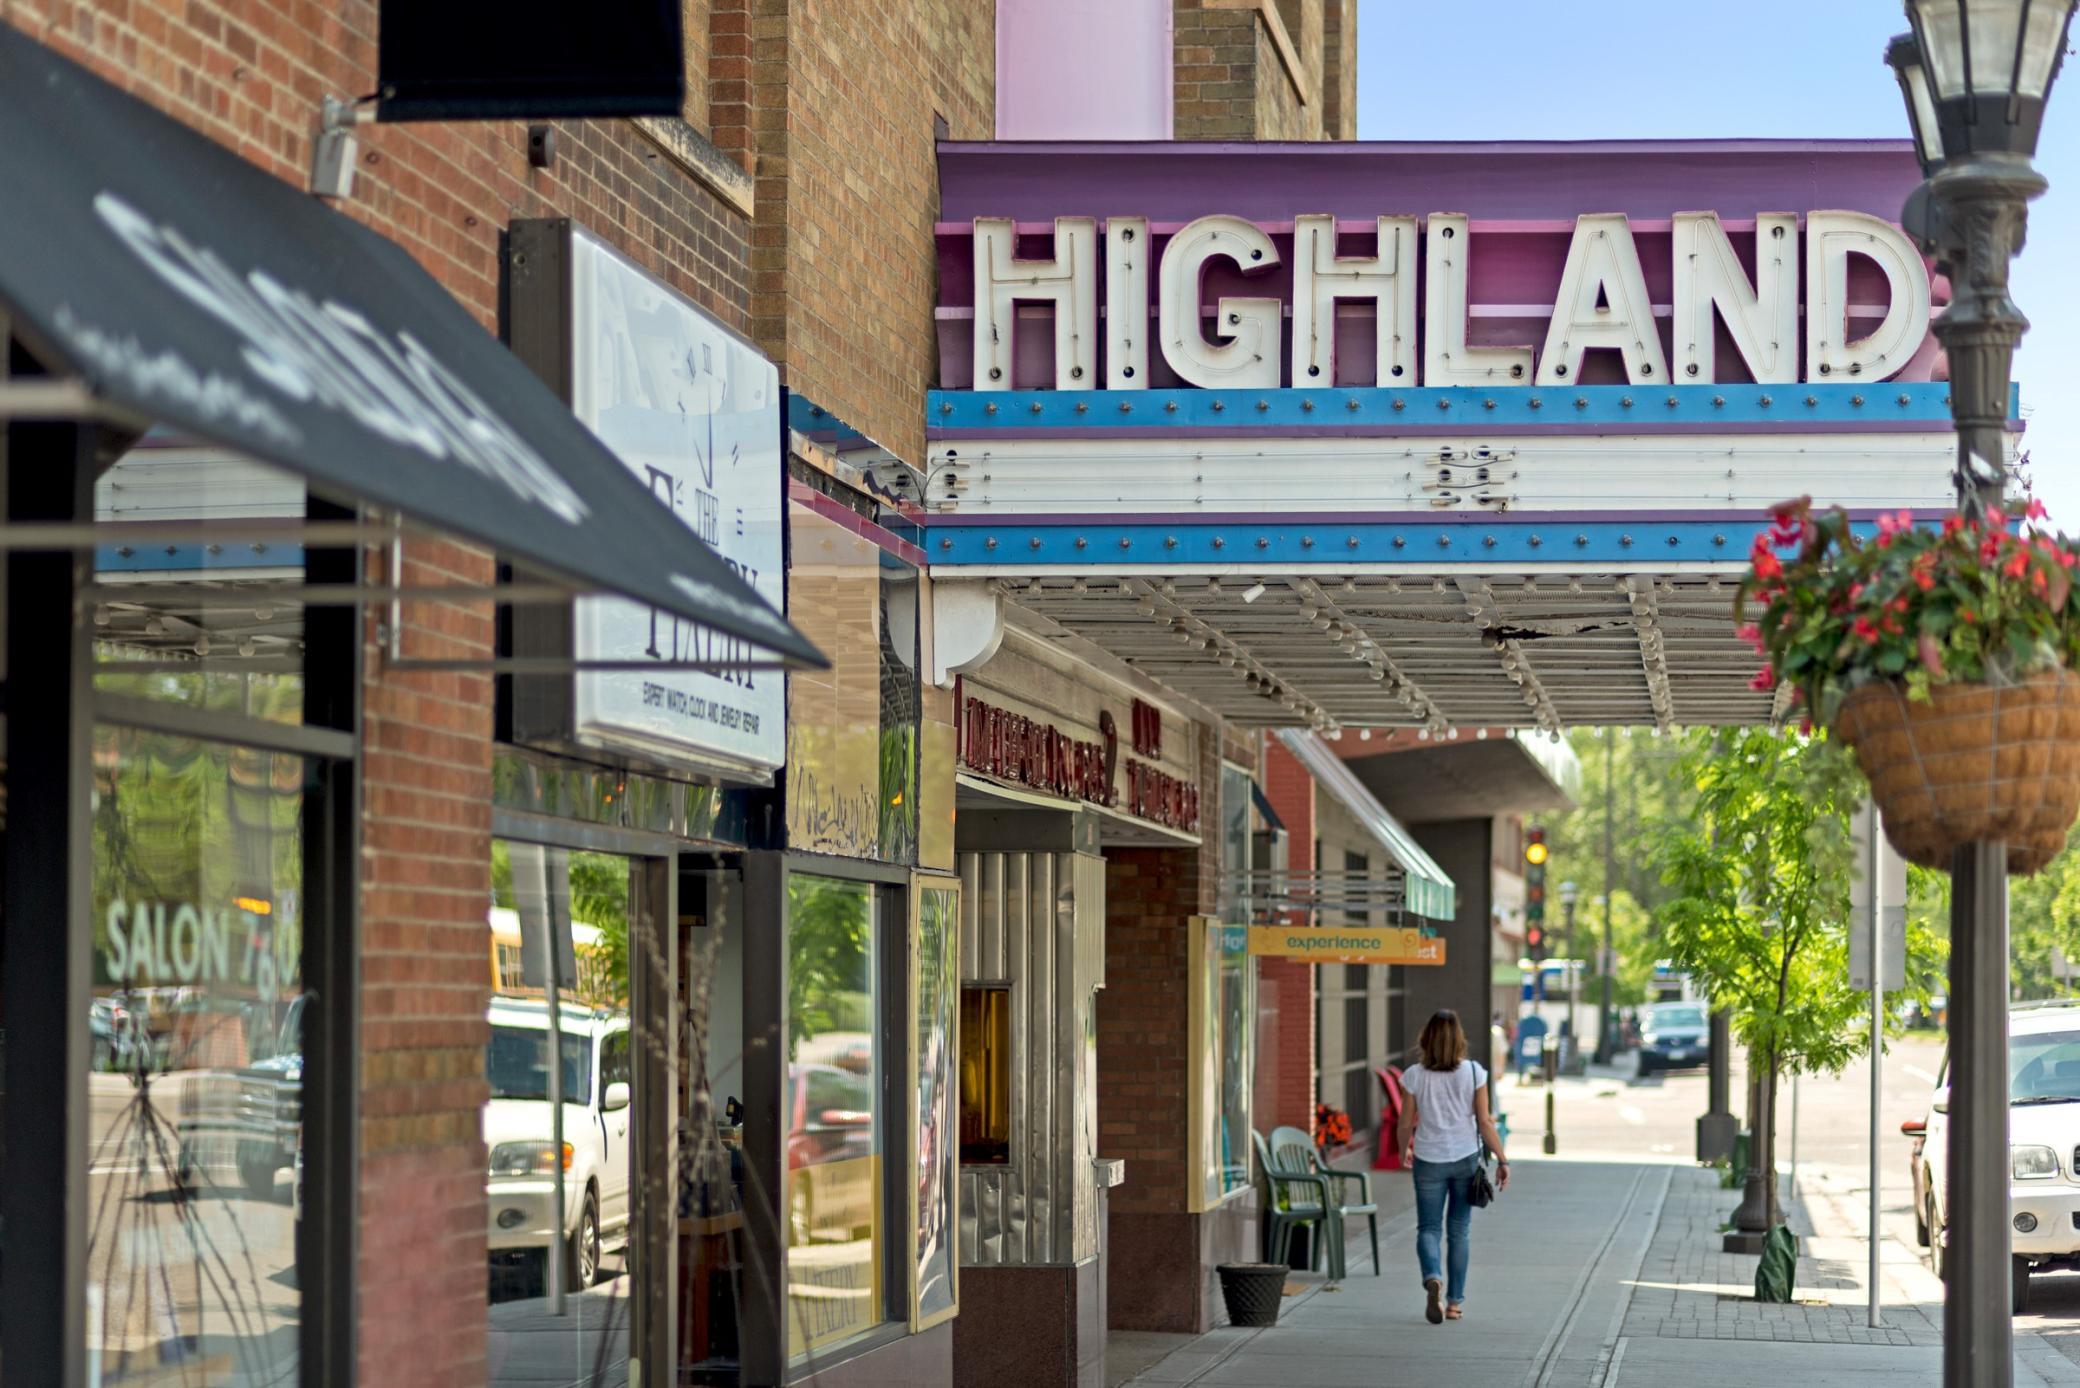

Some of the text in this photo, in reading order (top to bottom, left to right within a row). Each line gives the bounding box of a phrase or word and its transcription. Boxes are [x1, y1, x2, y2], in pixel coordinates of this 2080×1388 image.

[974, 209, 1932, 391] HIGHLAND
[695, 488, 720, 546] THE
[643, 681, 665, 708] EXPERT
[689, 695, 706, 719] CLOCK
[708, 701, 719, 724] AND
[743, 711, 760, 735] REPAIR
[106, 898, 230, 983] SALON
[1286, 934, 1382, 951] experience
